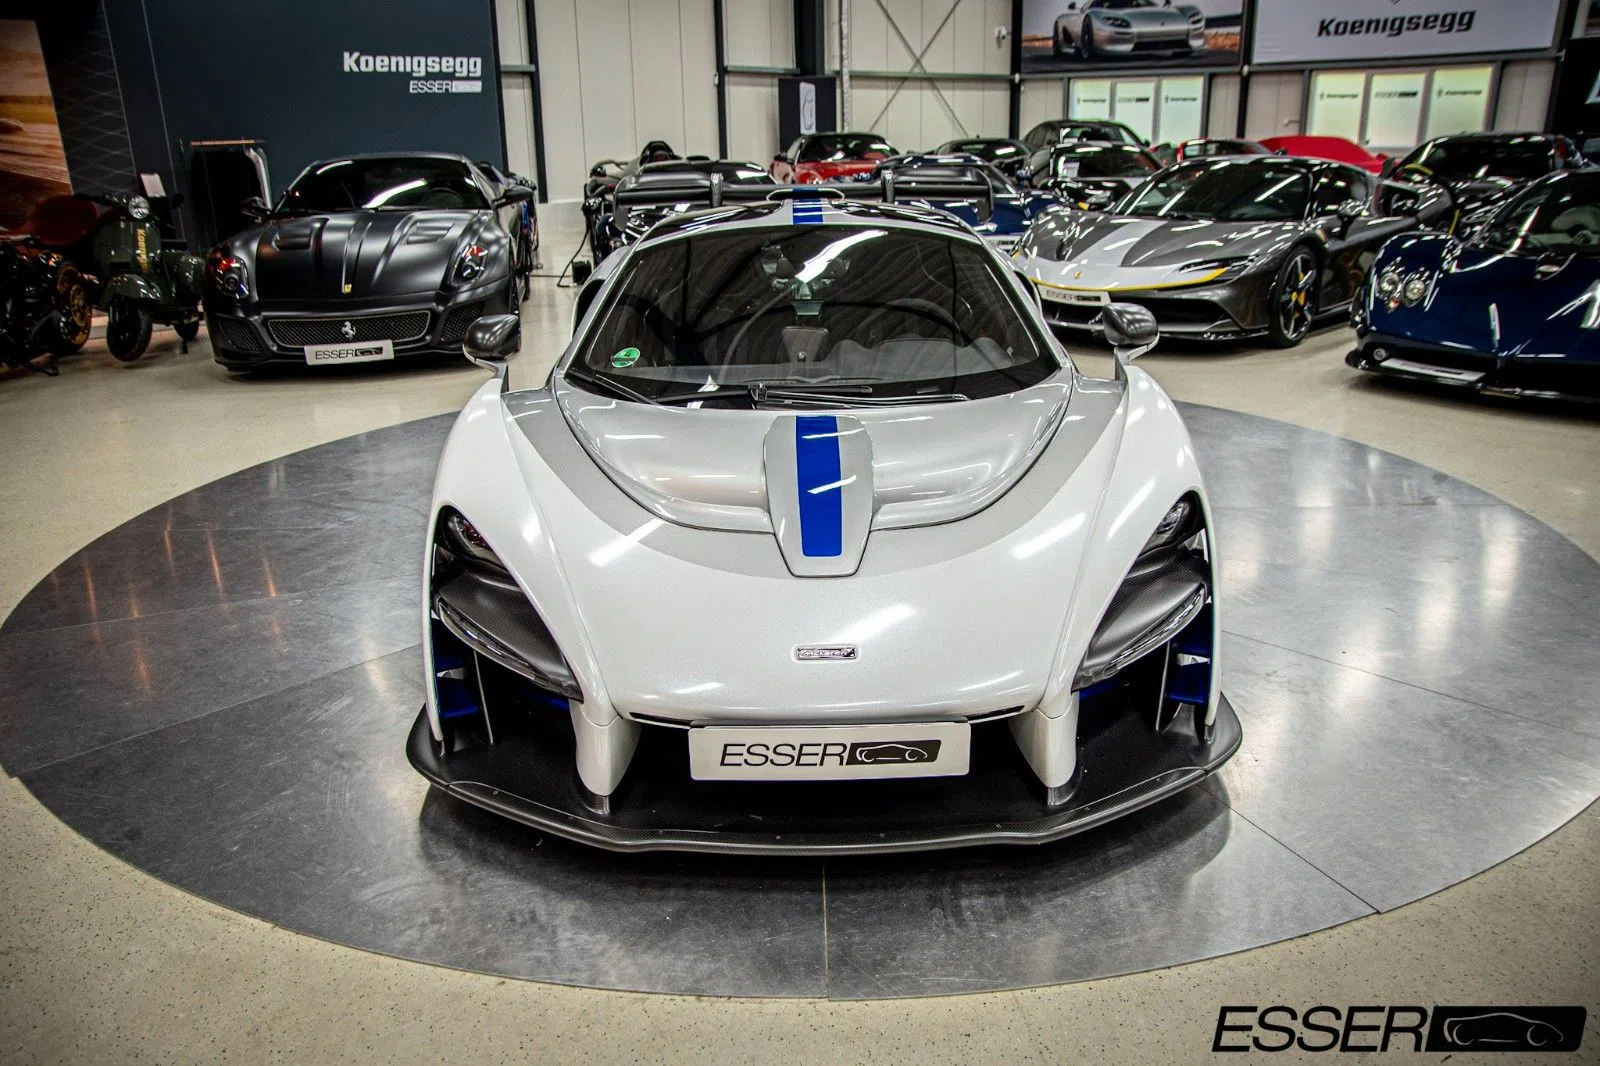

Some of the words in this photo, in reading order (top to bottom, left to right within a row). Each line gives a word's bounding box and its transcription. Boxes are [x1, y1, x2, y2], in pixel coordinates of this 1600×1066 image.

[1317, 10, 1476, 36] Koenigsegg
[343, 52, 482, 77] Koenigsegg
[410, 80, 452, 93] ESSER
[315, 350, 355, 360] ESSER
[720, 743, 847, 766] ESSER
